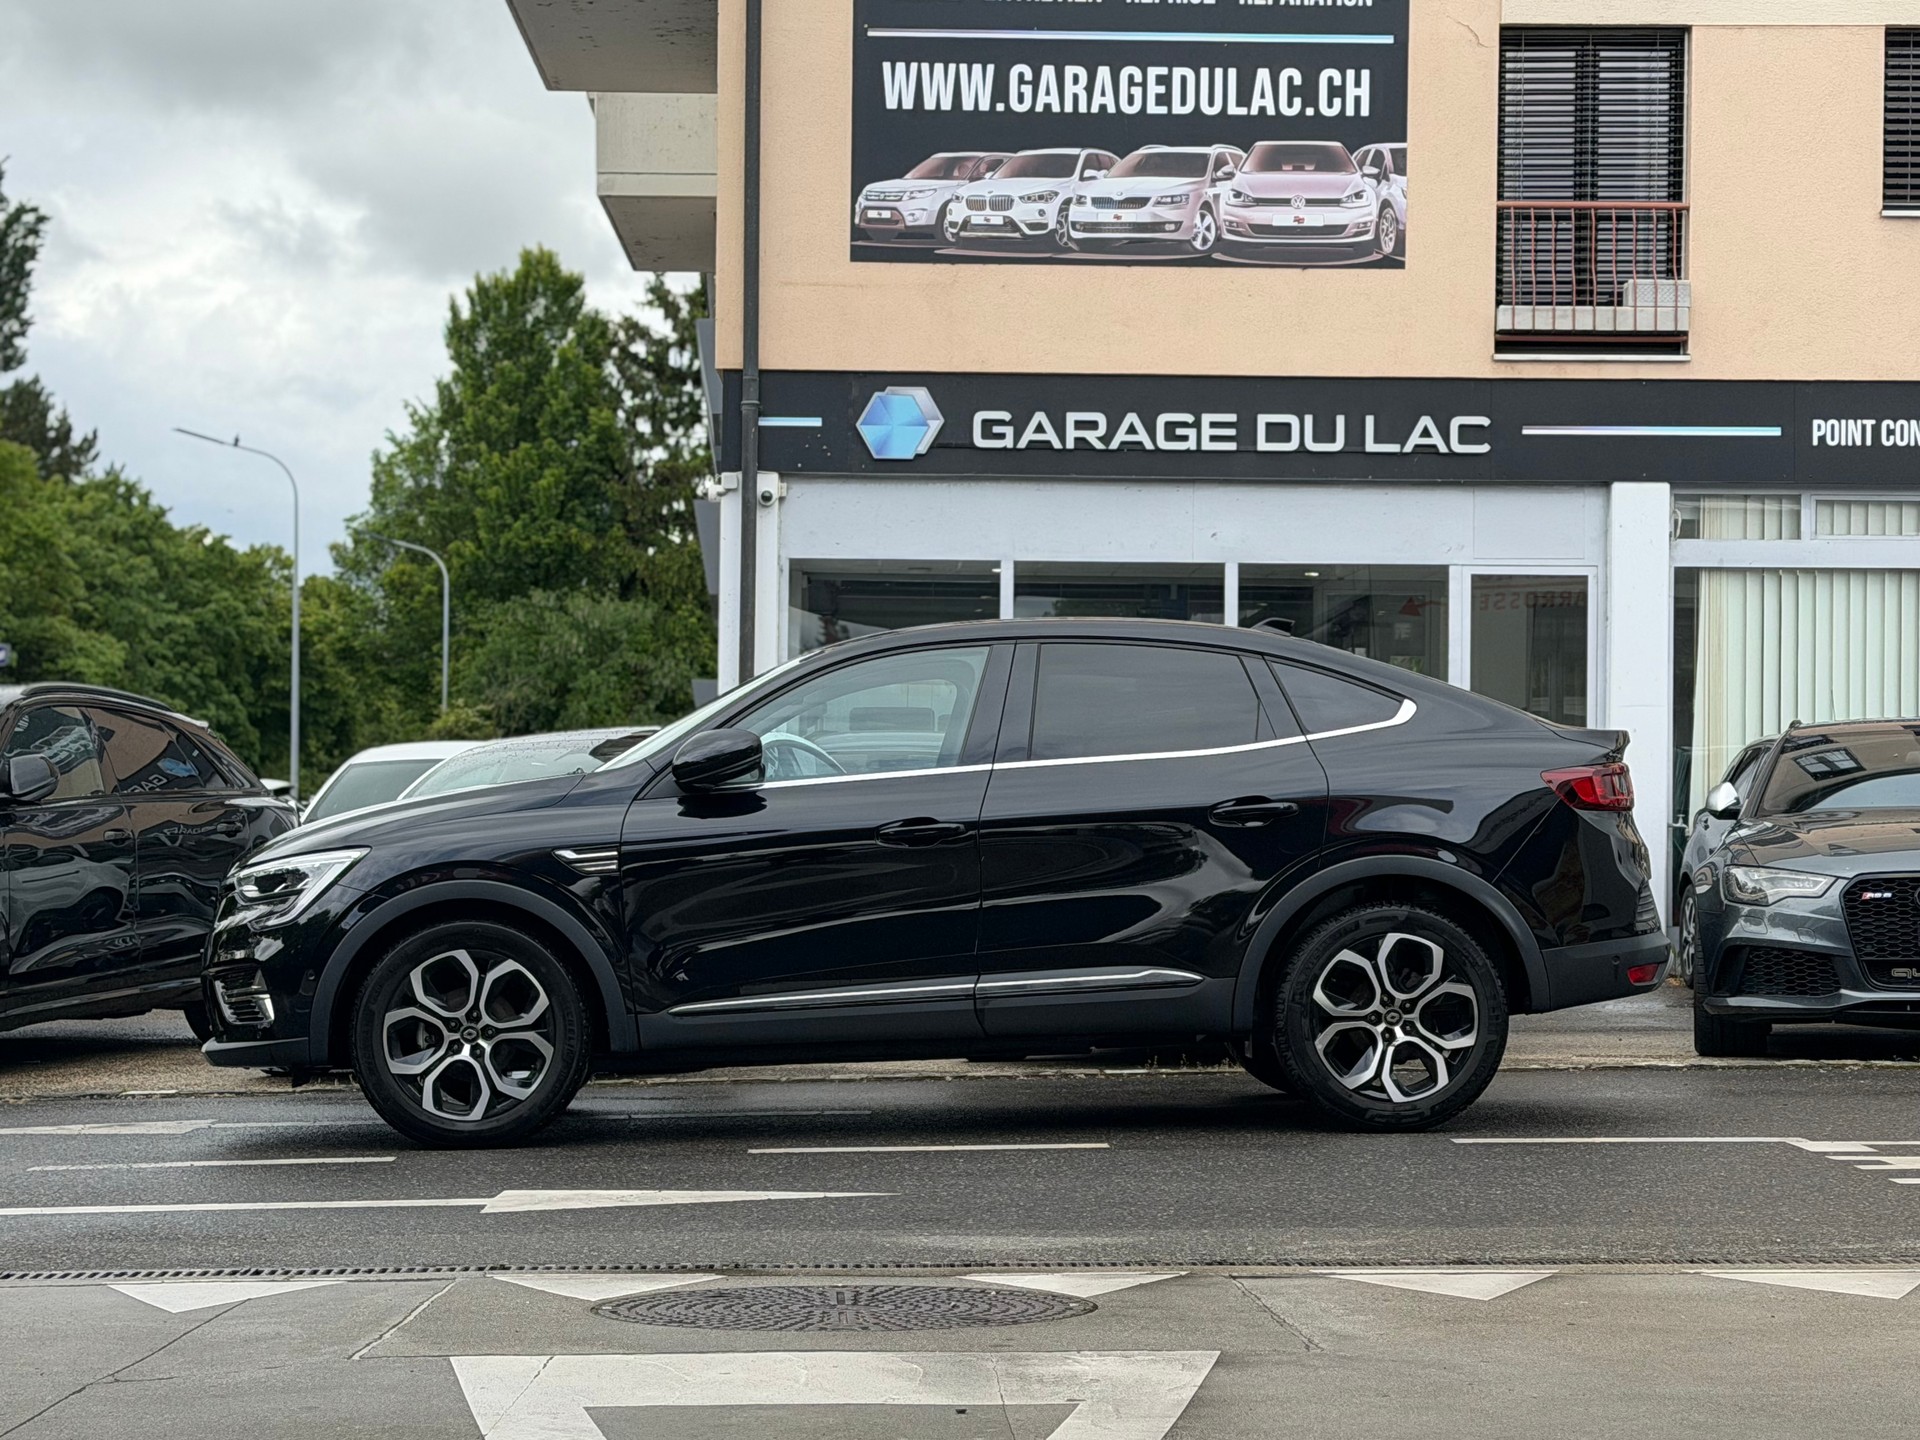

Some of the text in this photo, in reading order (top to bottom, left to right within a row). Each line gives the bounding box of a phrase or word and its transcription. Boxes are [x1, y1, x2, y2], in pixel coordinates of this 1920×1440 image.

[882, 61, 1371, 117] WWW.GARAGEDULAC.CH
[972, 410, 1492, 455] GARAGE DU LAC
[1812, 419, 1876, 447] POINT
